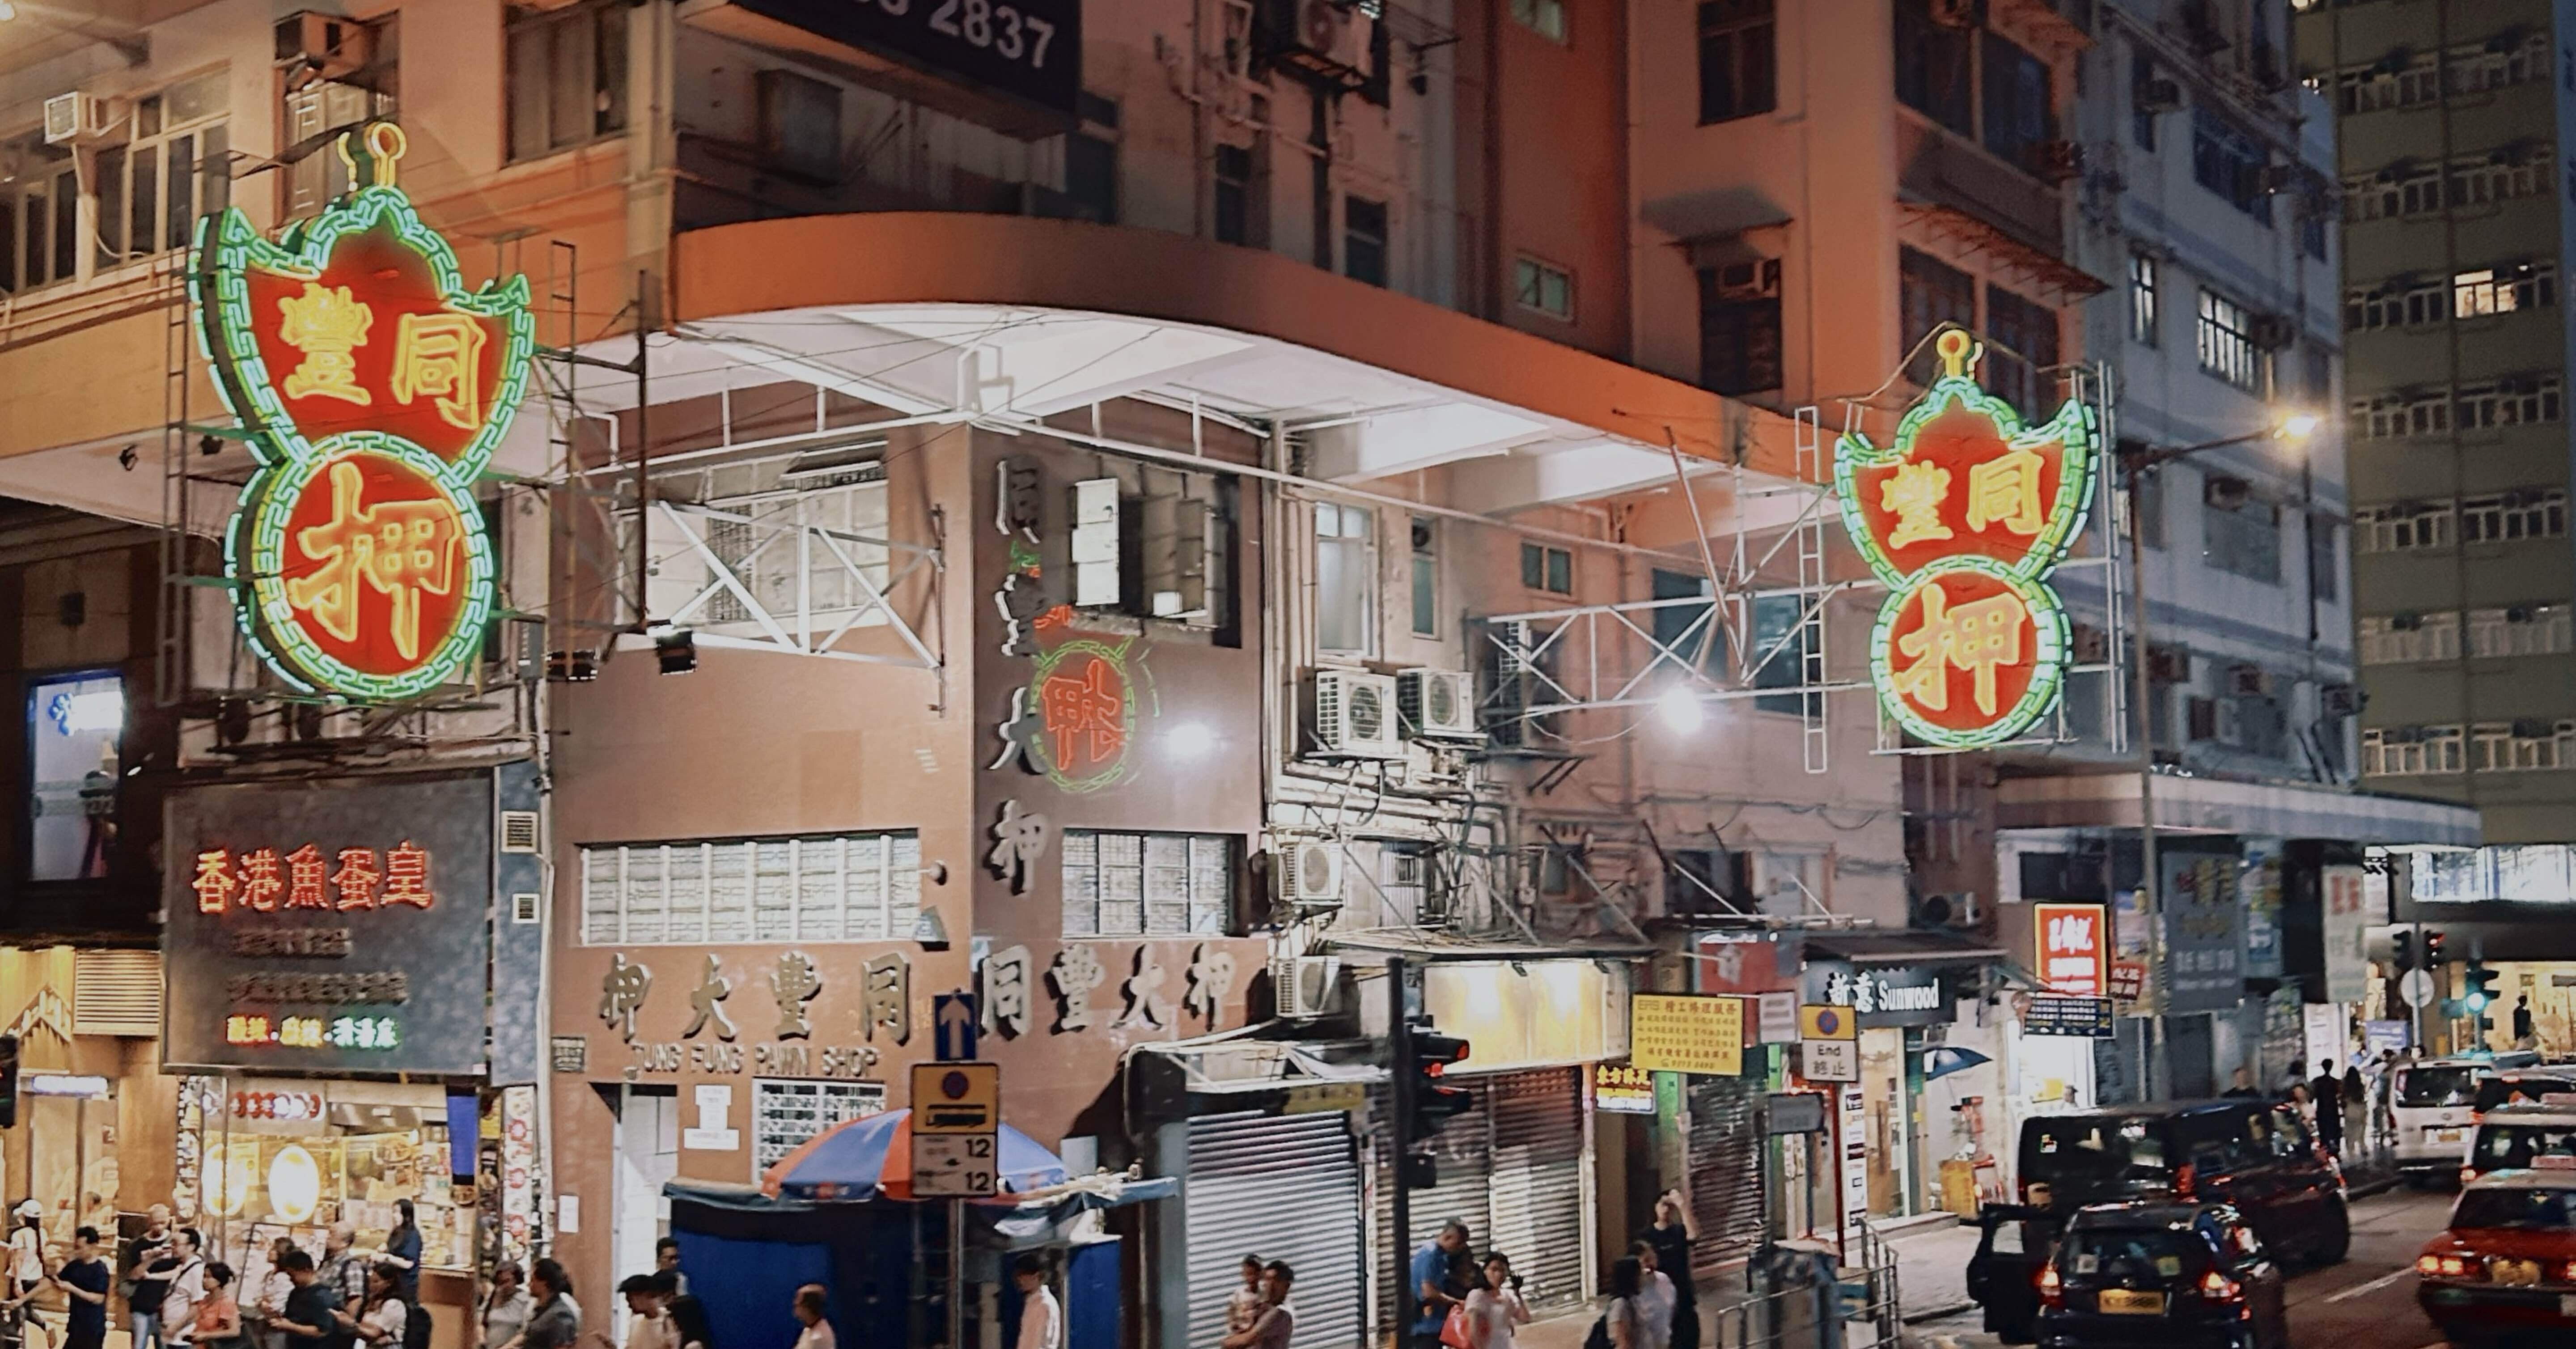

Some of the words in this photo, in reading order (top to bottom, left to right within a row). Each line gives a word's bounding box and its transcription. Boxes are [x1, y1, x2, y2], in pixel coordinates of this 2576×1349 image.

[929, 0, 1055, 68] 2837
[286, 461, 463, 660] 押
[1894, 583, 2026, 717] 押
[192, 838, 435, 915] 香港魚蛋皇
[1878, 977, 1940, 1012] Sunwood
[631, 1040, 684, 1072] TUNG
[691, 1043, 745, 1073] FUNG
[755, 1045, 810, 1075] PAWN
[822, 1046, 880, 1077] SHOP
[1817, 1044, 1842, 1056] End
[965, 1138, 991, 1158] 12
[965, 1171, 990, 1192] 12
